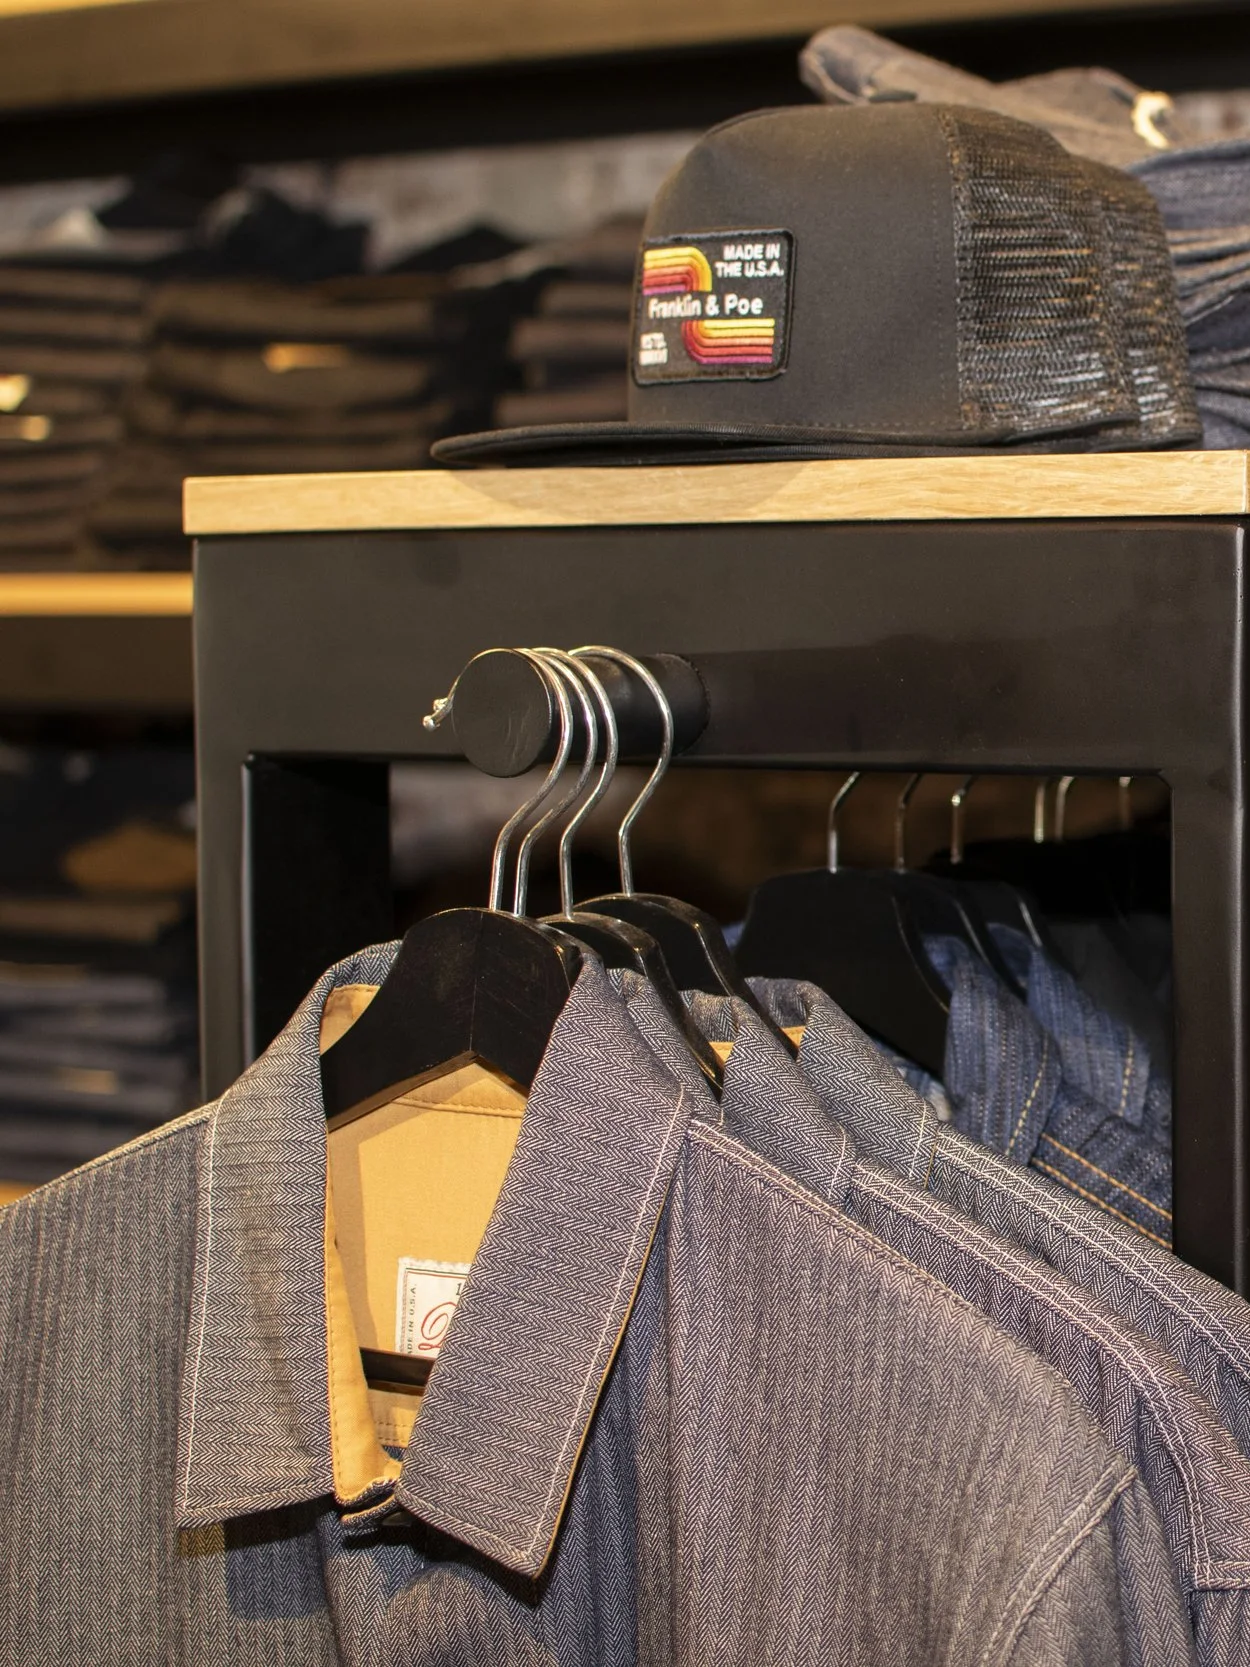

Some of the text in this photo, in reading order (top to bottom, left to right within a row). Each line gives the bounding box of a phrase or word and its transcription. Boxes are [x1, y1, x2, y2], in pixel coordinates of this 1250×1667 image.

[723, 243, 780, 260] MADE IN
[715, 260, 784, 278] THE U.S.A.
[648, 293, 763, 319] Franklin & Poe
[408, 1321, 414, 1332] IN
